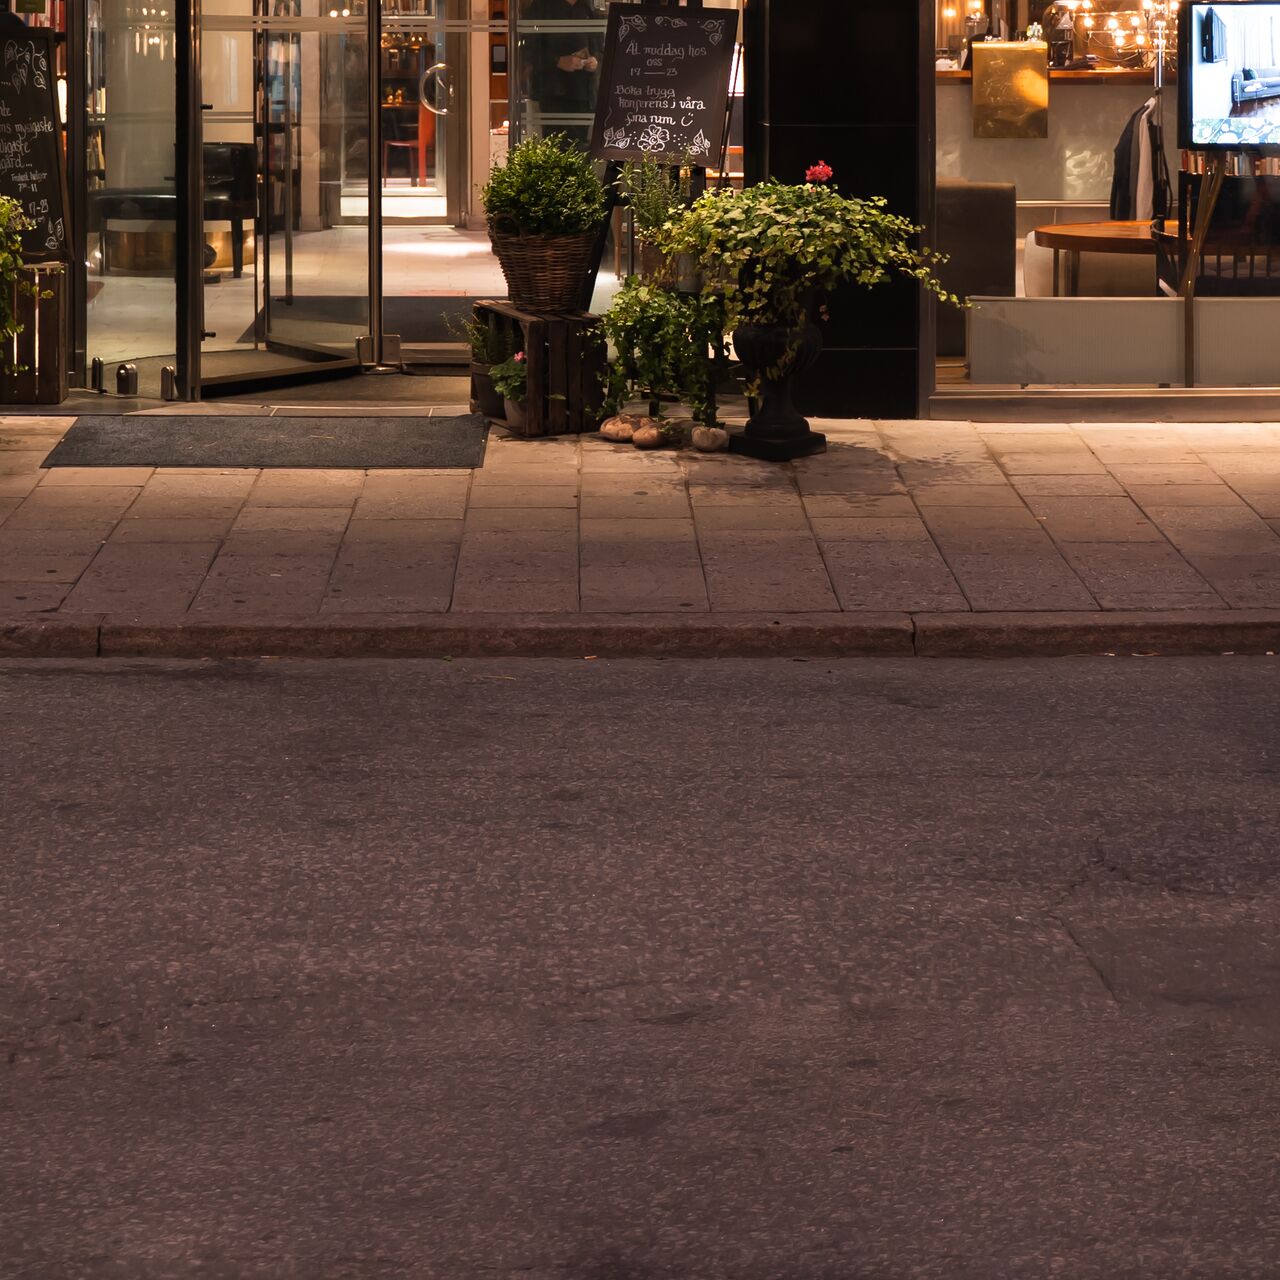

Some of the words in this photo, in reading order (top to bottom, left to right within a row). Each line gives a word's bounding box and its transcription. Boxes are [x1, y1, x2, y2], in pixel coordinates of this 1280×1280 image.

[688, 43, 708, 57] hos
[646, 58, 663, 67] oss
[614, 85, 642, 96] Boka
[618, 96, 669, 112] konferens
[678, 96, 707, 110] våra
[625, 111, 648, 127] fina
[649, 114, 677, 126] rum
